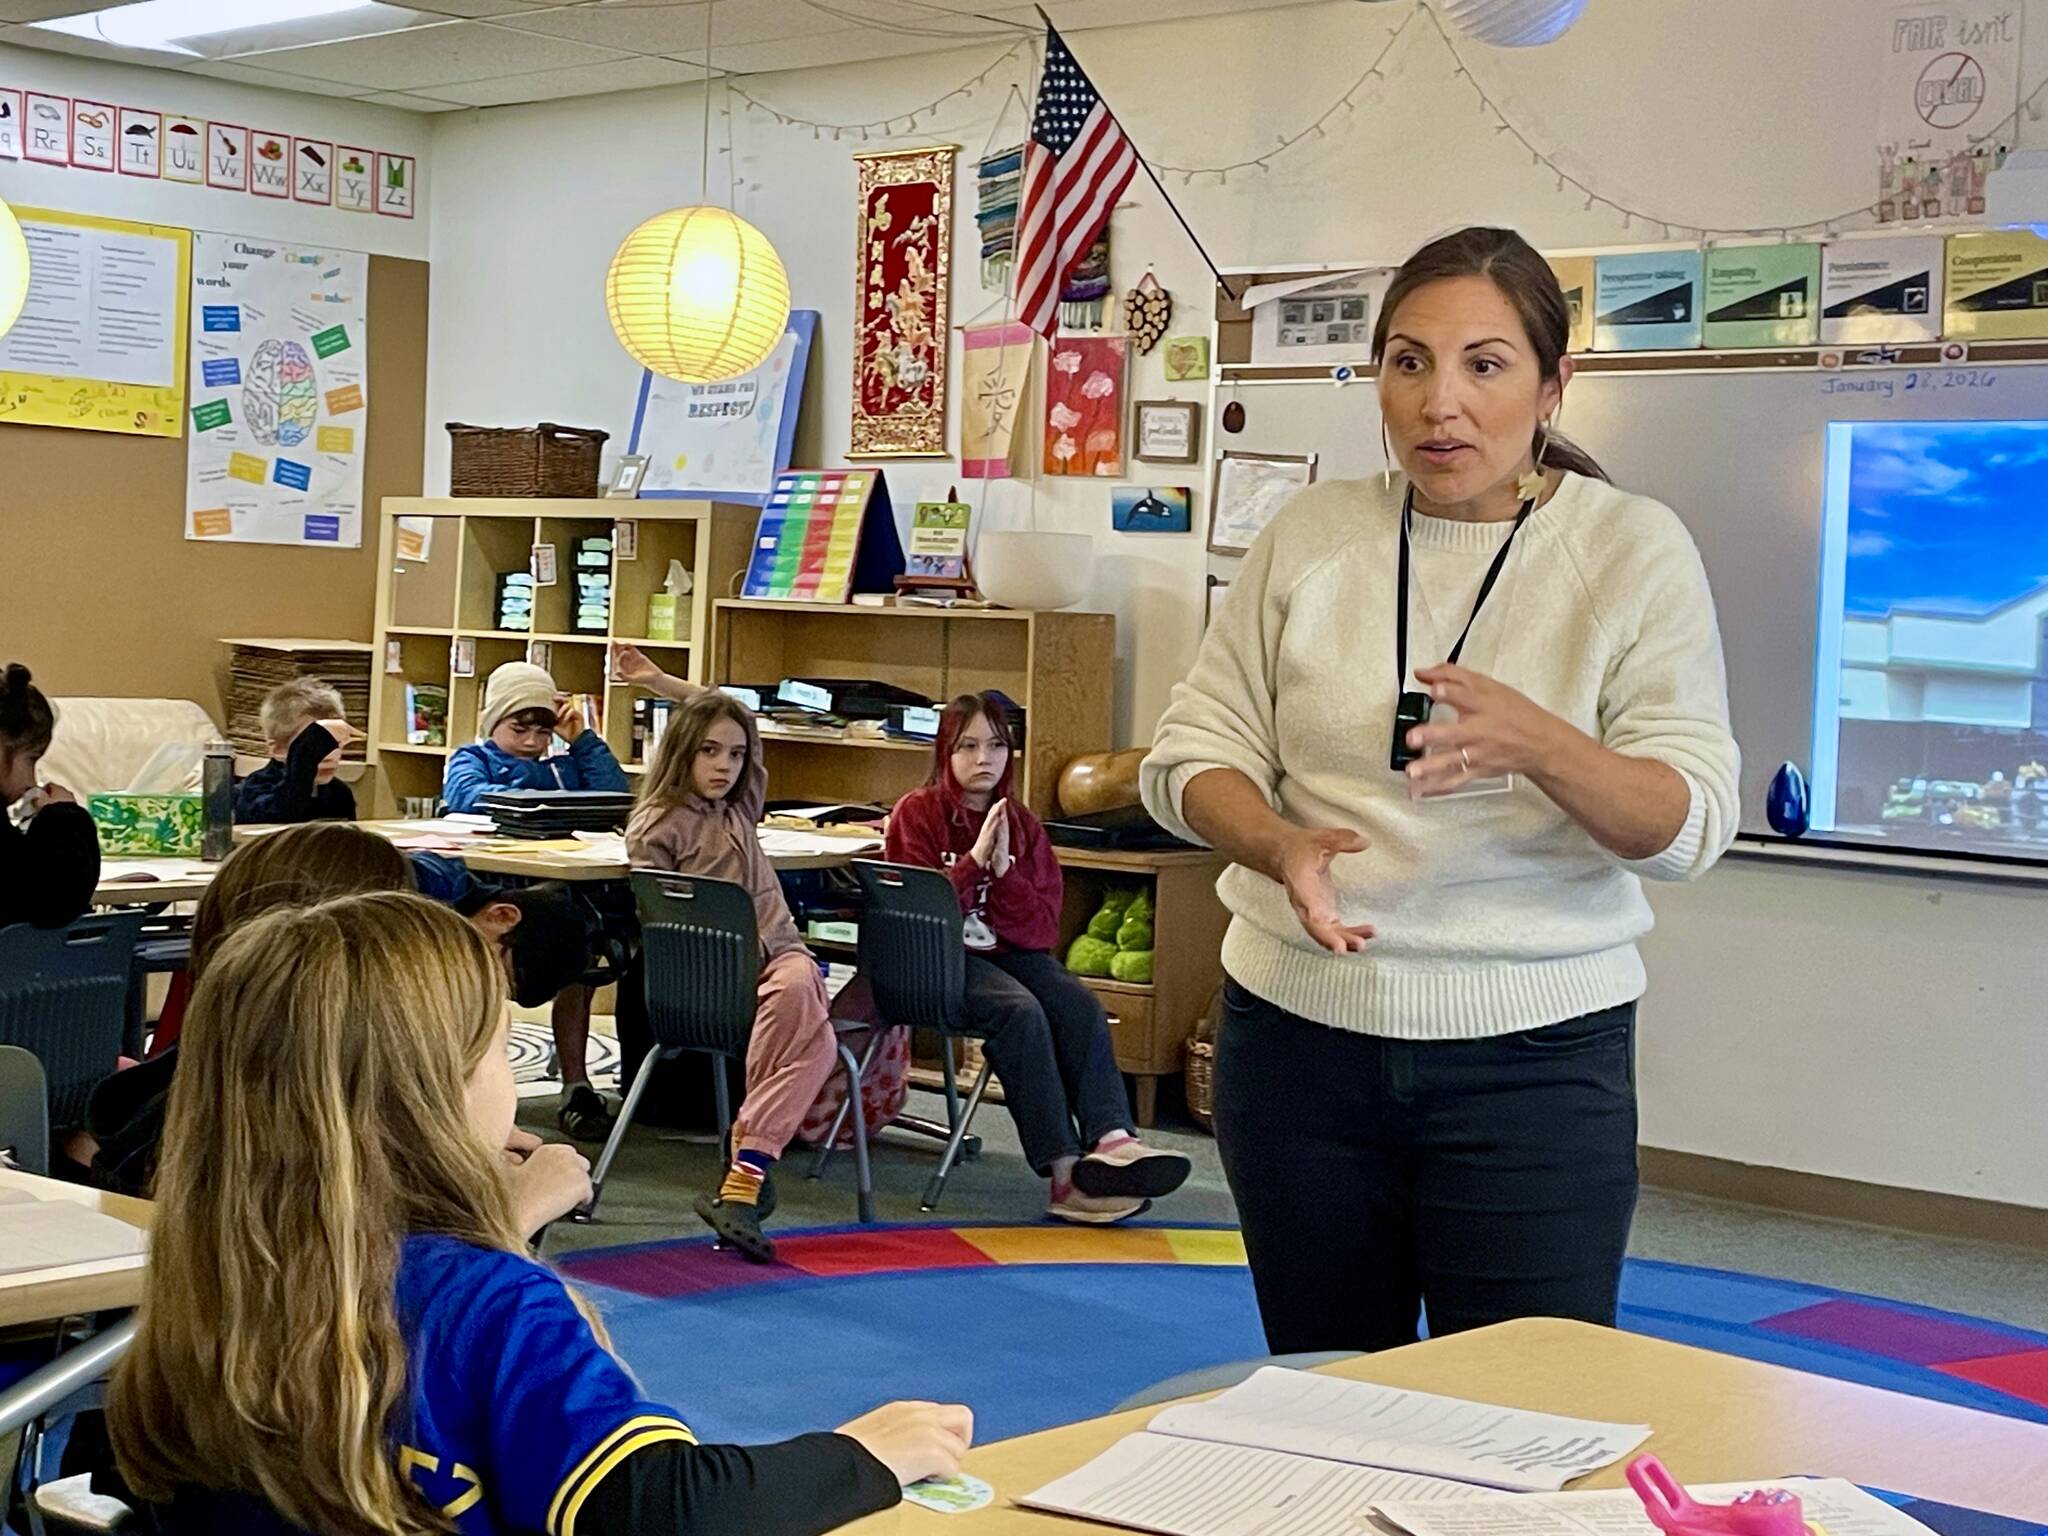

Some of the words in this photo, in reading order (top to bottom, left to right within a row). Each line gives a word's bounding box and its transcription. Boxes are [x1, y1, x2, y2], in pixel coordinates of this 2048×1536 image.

[33, 127, 58, 150] Rr
[83, 136, 104, 158] Ss
[130, 143, 149, 164] Tt
[172, 147, 196, 170] Uu
[215, 156, 237, 178] Vv
[252, 162, 286, 186] Ww
[301, 171, 324, 193] Xx
[344, 178, 365, 206] Yy
[385, 186, 406, 206] Zz
[233, 242, 276, 259] Change
[1952, 251, 2022, 268] Cooperation
[222, 261, 249, 271] your
[1711, 266, 1757, 280] Empathy
[196, 276, 232, 288] words
[1819, 377, 1895, 399] January
[1943, 370, 1998, 388] 2026
